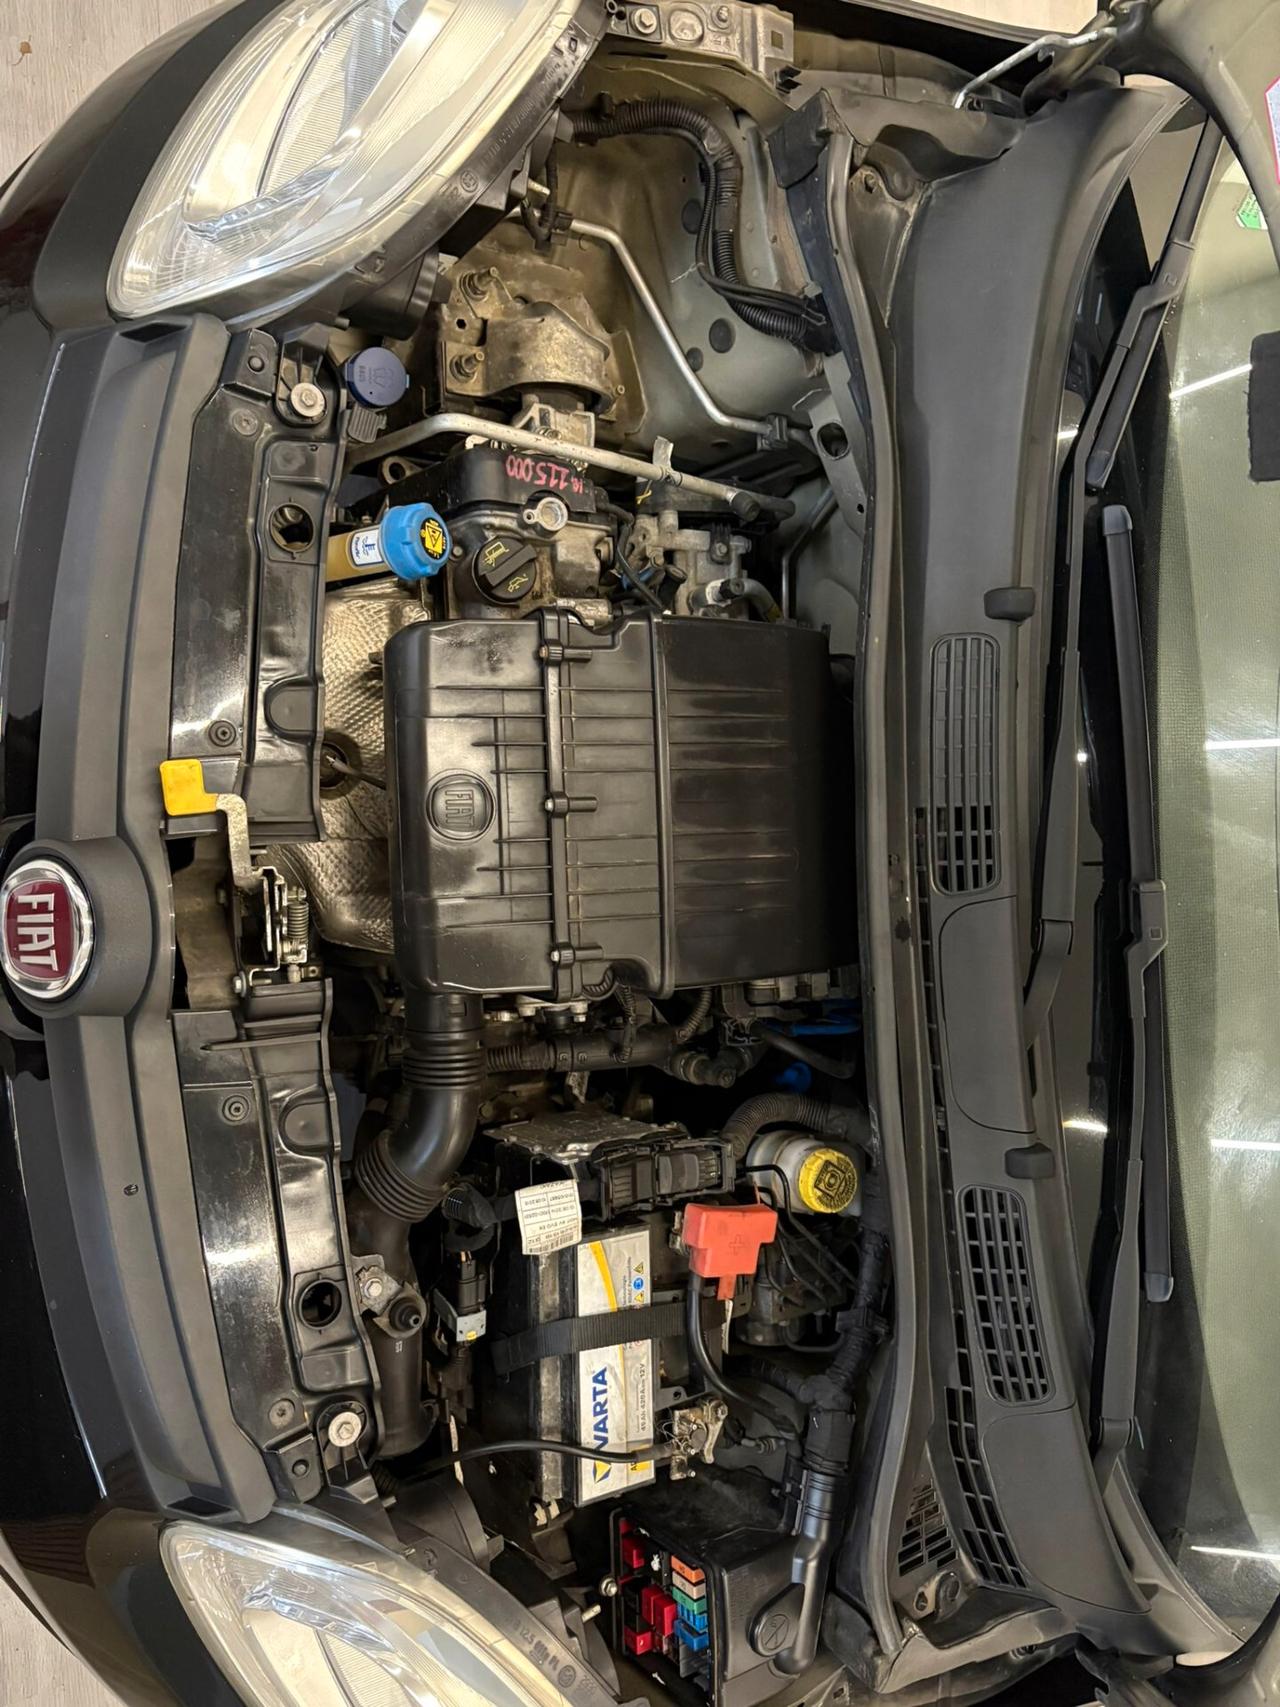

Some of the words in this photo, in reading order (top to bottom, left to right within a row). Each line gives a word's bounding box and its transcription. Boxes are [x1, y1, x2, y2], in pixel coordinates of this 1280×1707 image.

[445, 790, 475, 828] FIAT
[17, 892, 59, 972] FIAT
[591, 1366, 609, 1451] VARTA
